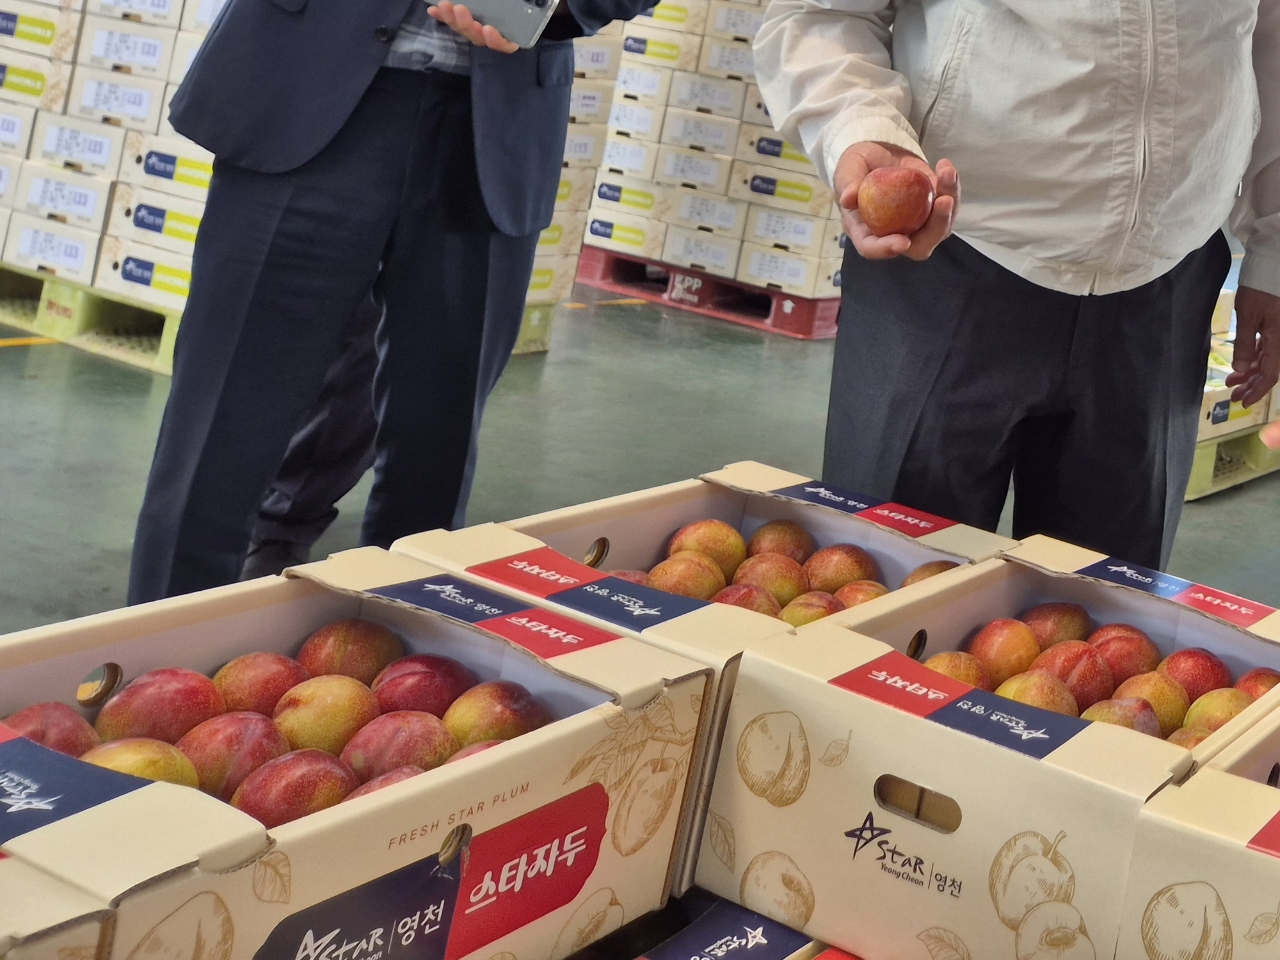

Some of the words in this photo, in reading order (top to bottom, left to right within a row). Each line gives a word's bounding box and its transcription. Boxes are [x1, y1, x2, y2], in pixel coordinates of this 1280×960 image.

[388, 820, 440, 850] FRESH
[447, 801, 485, 826] STAR
[492, 782, 531, 807] PLUM
[464, 825, 589, 915] 스타자두
[934, 872, 963, 898] 영천
[397, 900, 445, 946] 영천
